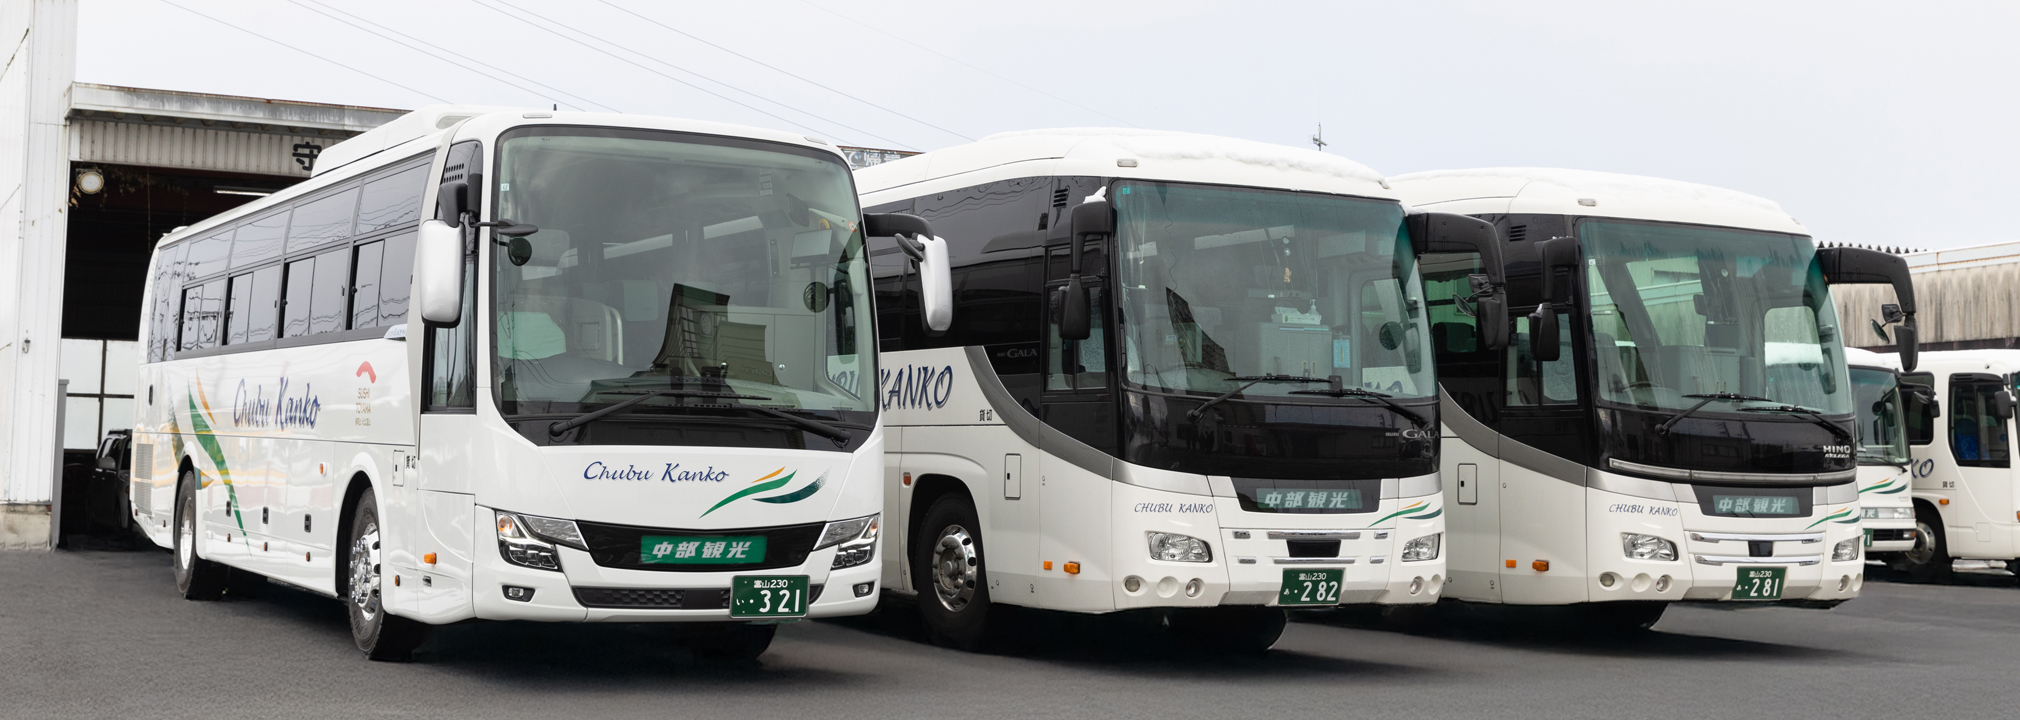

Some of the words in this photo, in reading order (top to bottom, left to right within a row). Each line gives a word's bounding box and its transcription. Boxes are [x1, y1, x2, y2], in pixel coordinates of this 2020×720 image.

[292, 141, 322, 172] 守
[1007, 348, 1038, 358] GALA
[880, 364, 953, 411] KANKO
[234, 378, 270, 428] Chubu
[275, 376, 321, 432] Kanko
[1402, 429, 1440, 439] GALA
[1823, 445, 1851, 453] HINO
[583, 461, 653, 481] Chubu
[661, 462, 730, 483] Kanko
[1134, 502, 1173, 513] CHUBU
[1178, 503, 1214, 514] KANKO
[1264, 491, 1349, 508] 中部観光
[1608, 498, 1645, 514] CHUBU
[1649, 505, 1679, 517] KANKO
[1718, 497, 1787, 513] 中部観光
[652, 541, 752, 559] 中部観光
